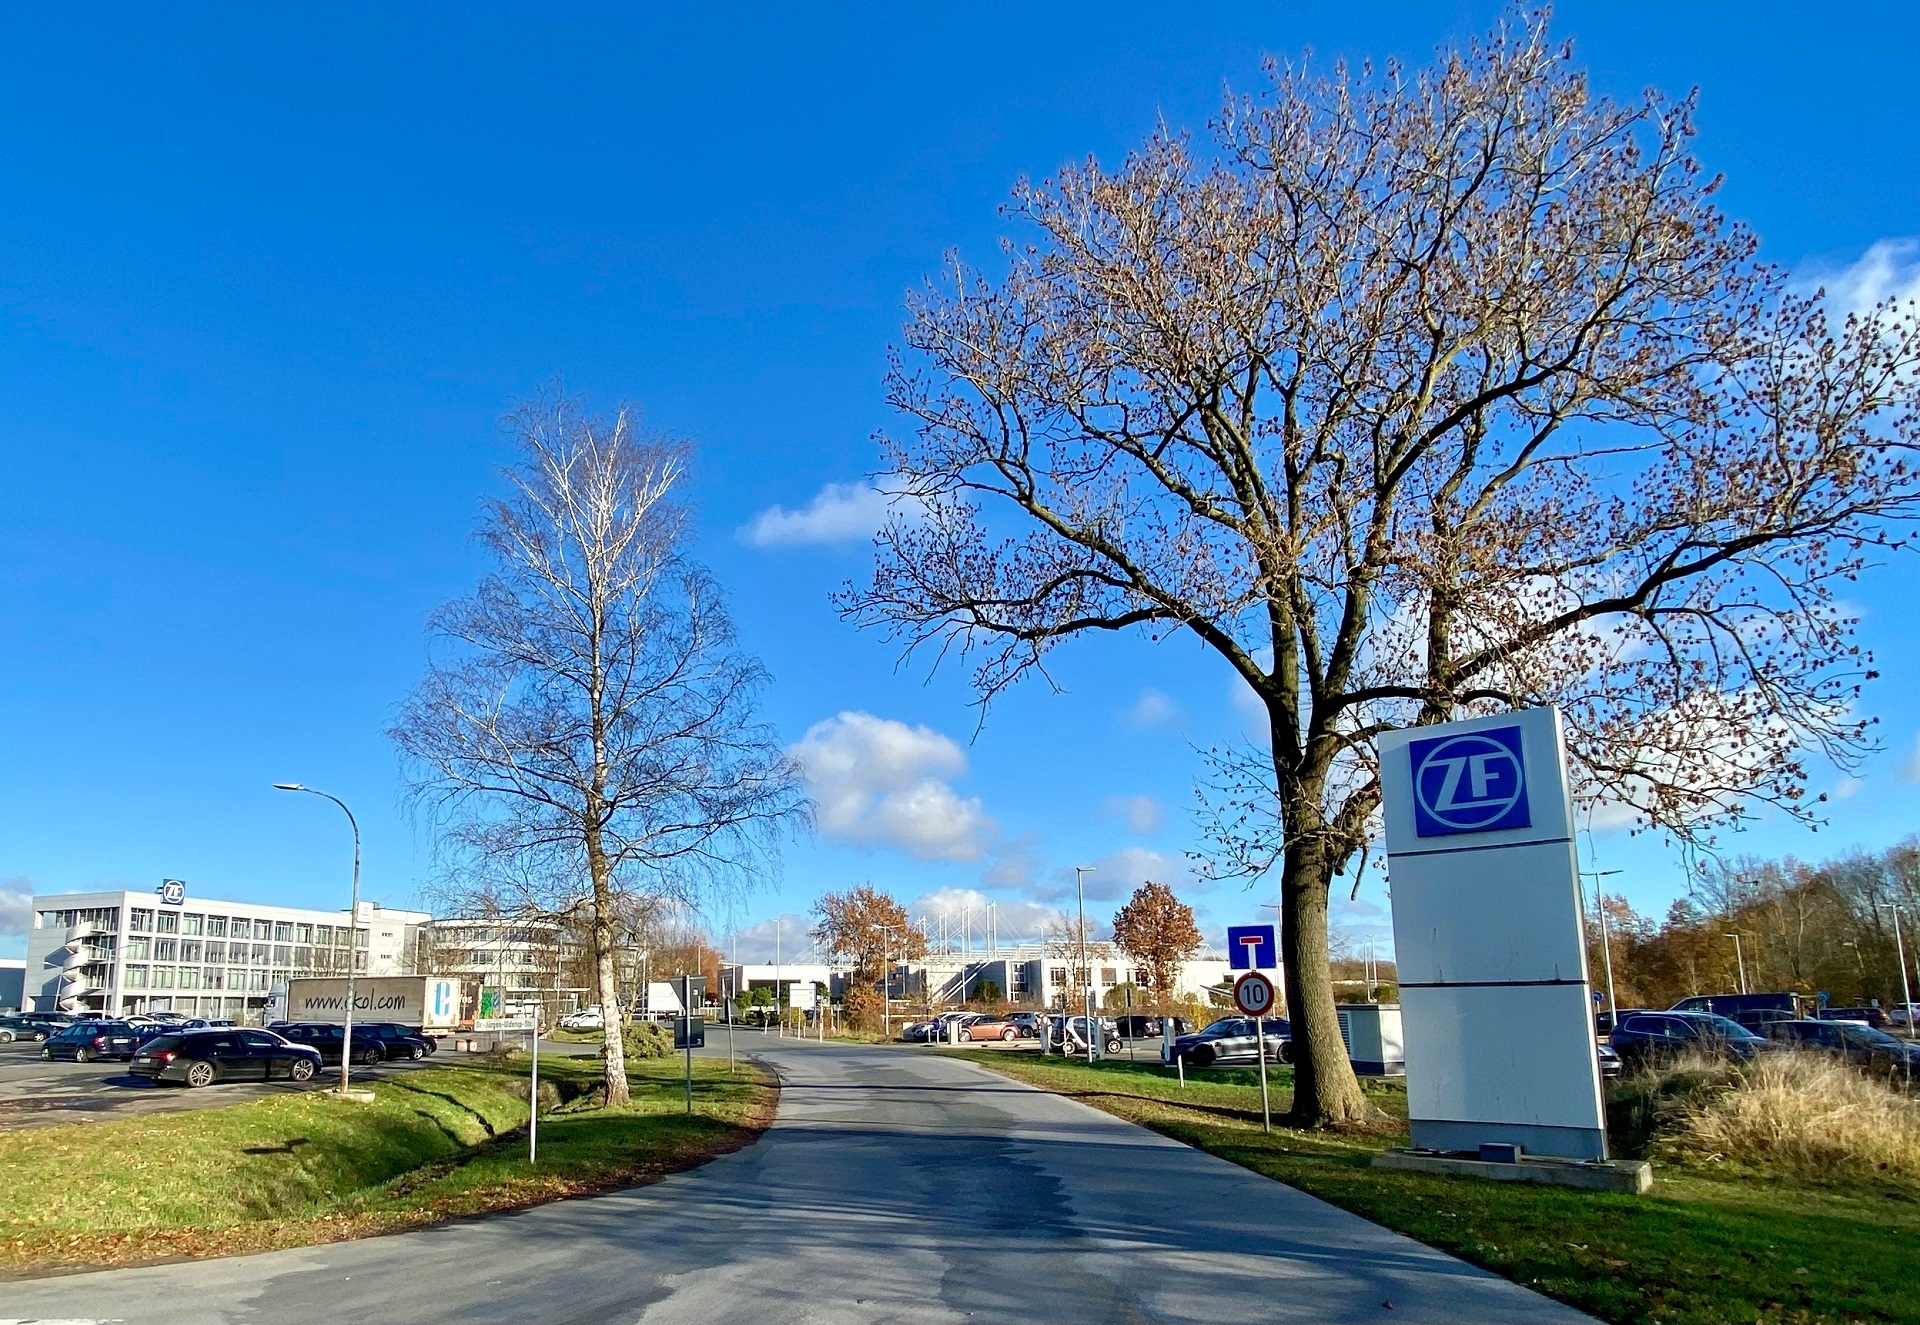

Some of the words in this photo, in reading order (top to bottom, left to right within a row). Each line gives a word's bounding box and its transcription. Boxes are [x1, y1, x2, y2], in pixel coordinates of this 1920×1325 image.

[1422, 751, 1514, 812] ZF
[165, 884, 184, 899] ZF
[305, 987, 406, 1011] www.kol.com
[1243, 983, 1265, 1005] 10
